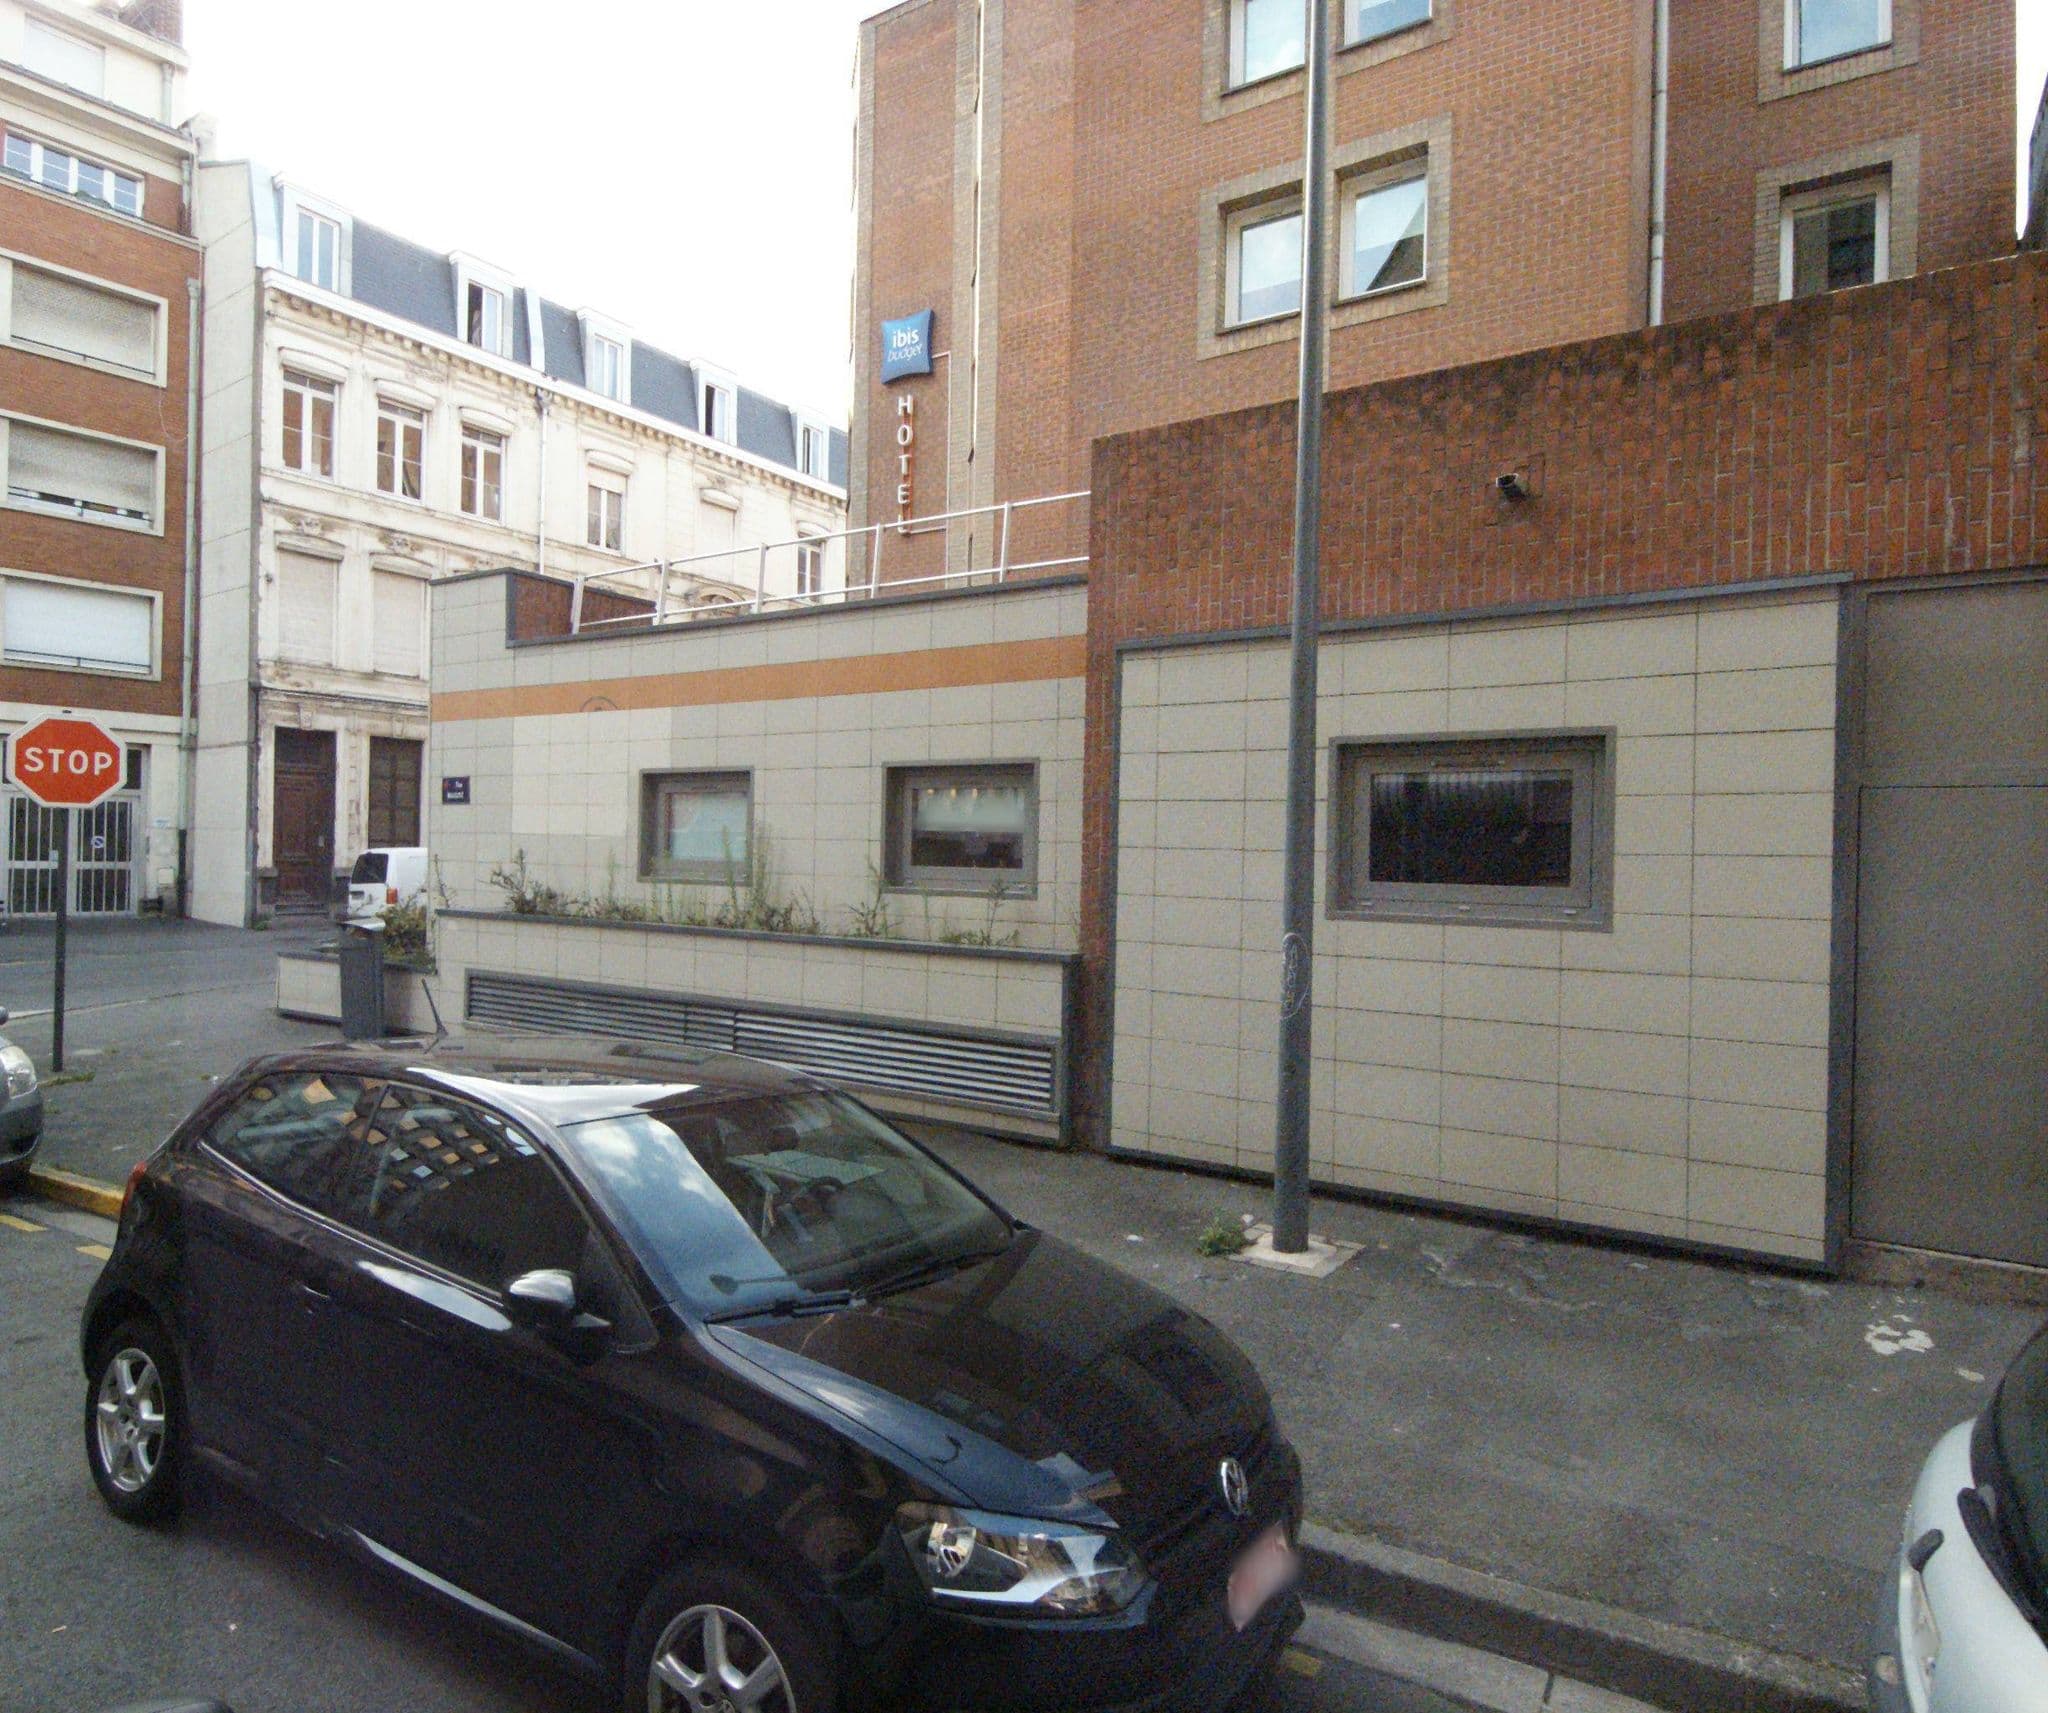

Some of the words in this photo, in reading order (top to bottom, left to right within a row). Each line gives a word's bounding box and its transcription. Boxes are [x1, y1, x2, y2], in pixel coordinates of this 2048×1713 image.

[891, 327, 920, 349] ibis
[897, 394, 912, 533] HOTEL
[24, 747, 113, 776] STOP
